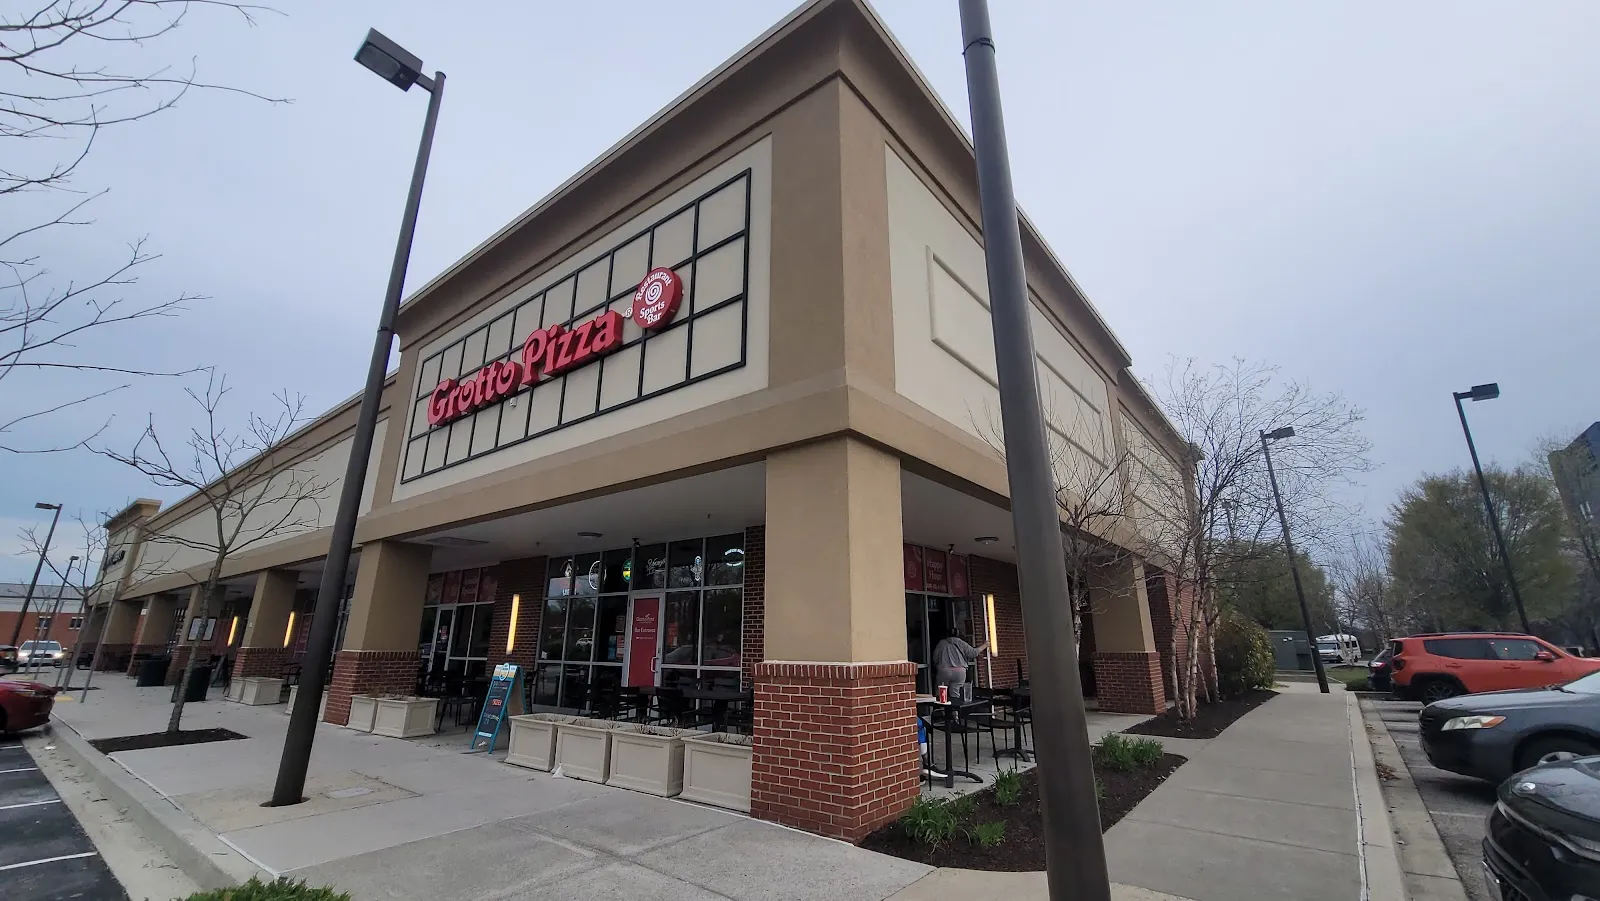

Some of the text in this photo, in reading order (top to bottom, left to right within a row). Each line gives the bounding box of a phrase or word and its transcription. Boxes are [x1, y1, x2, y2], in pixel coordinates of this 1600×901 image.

[635, 271, 672, 301] Restaurant
[640, 301, 665, 320] Sports
[647, 312, 662, 325] Bar
[427, 360, 519, 425] Grotto
[521, 309, 620, 386] Pizza
